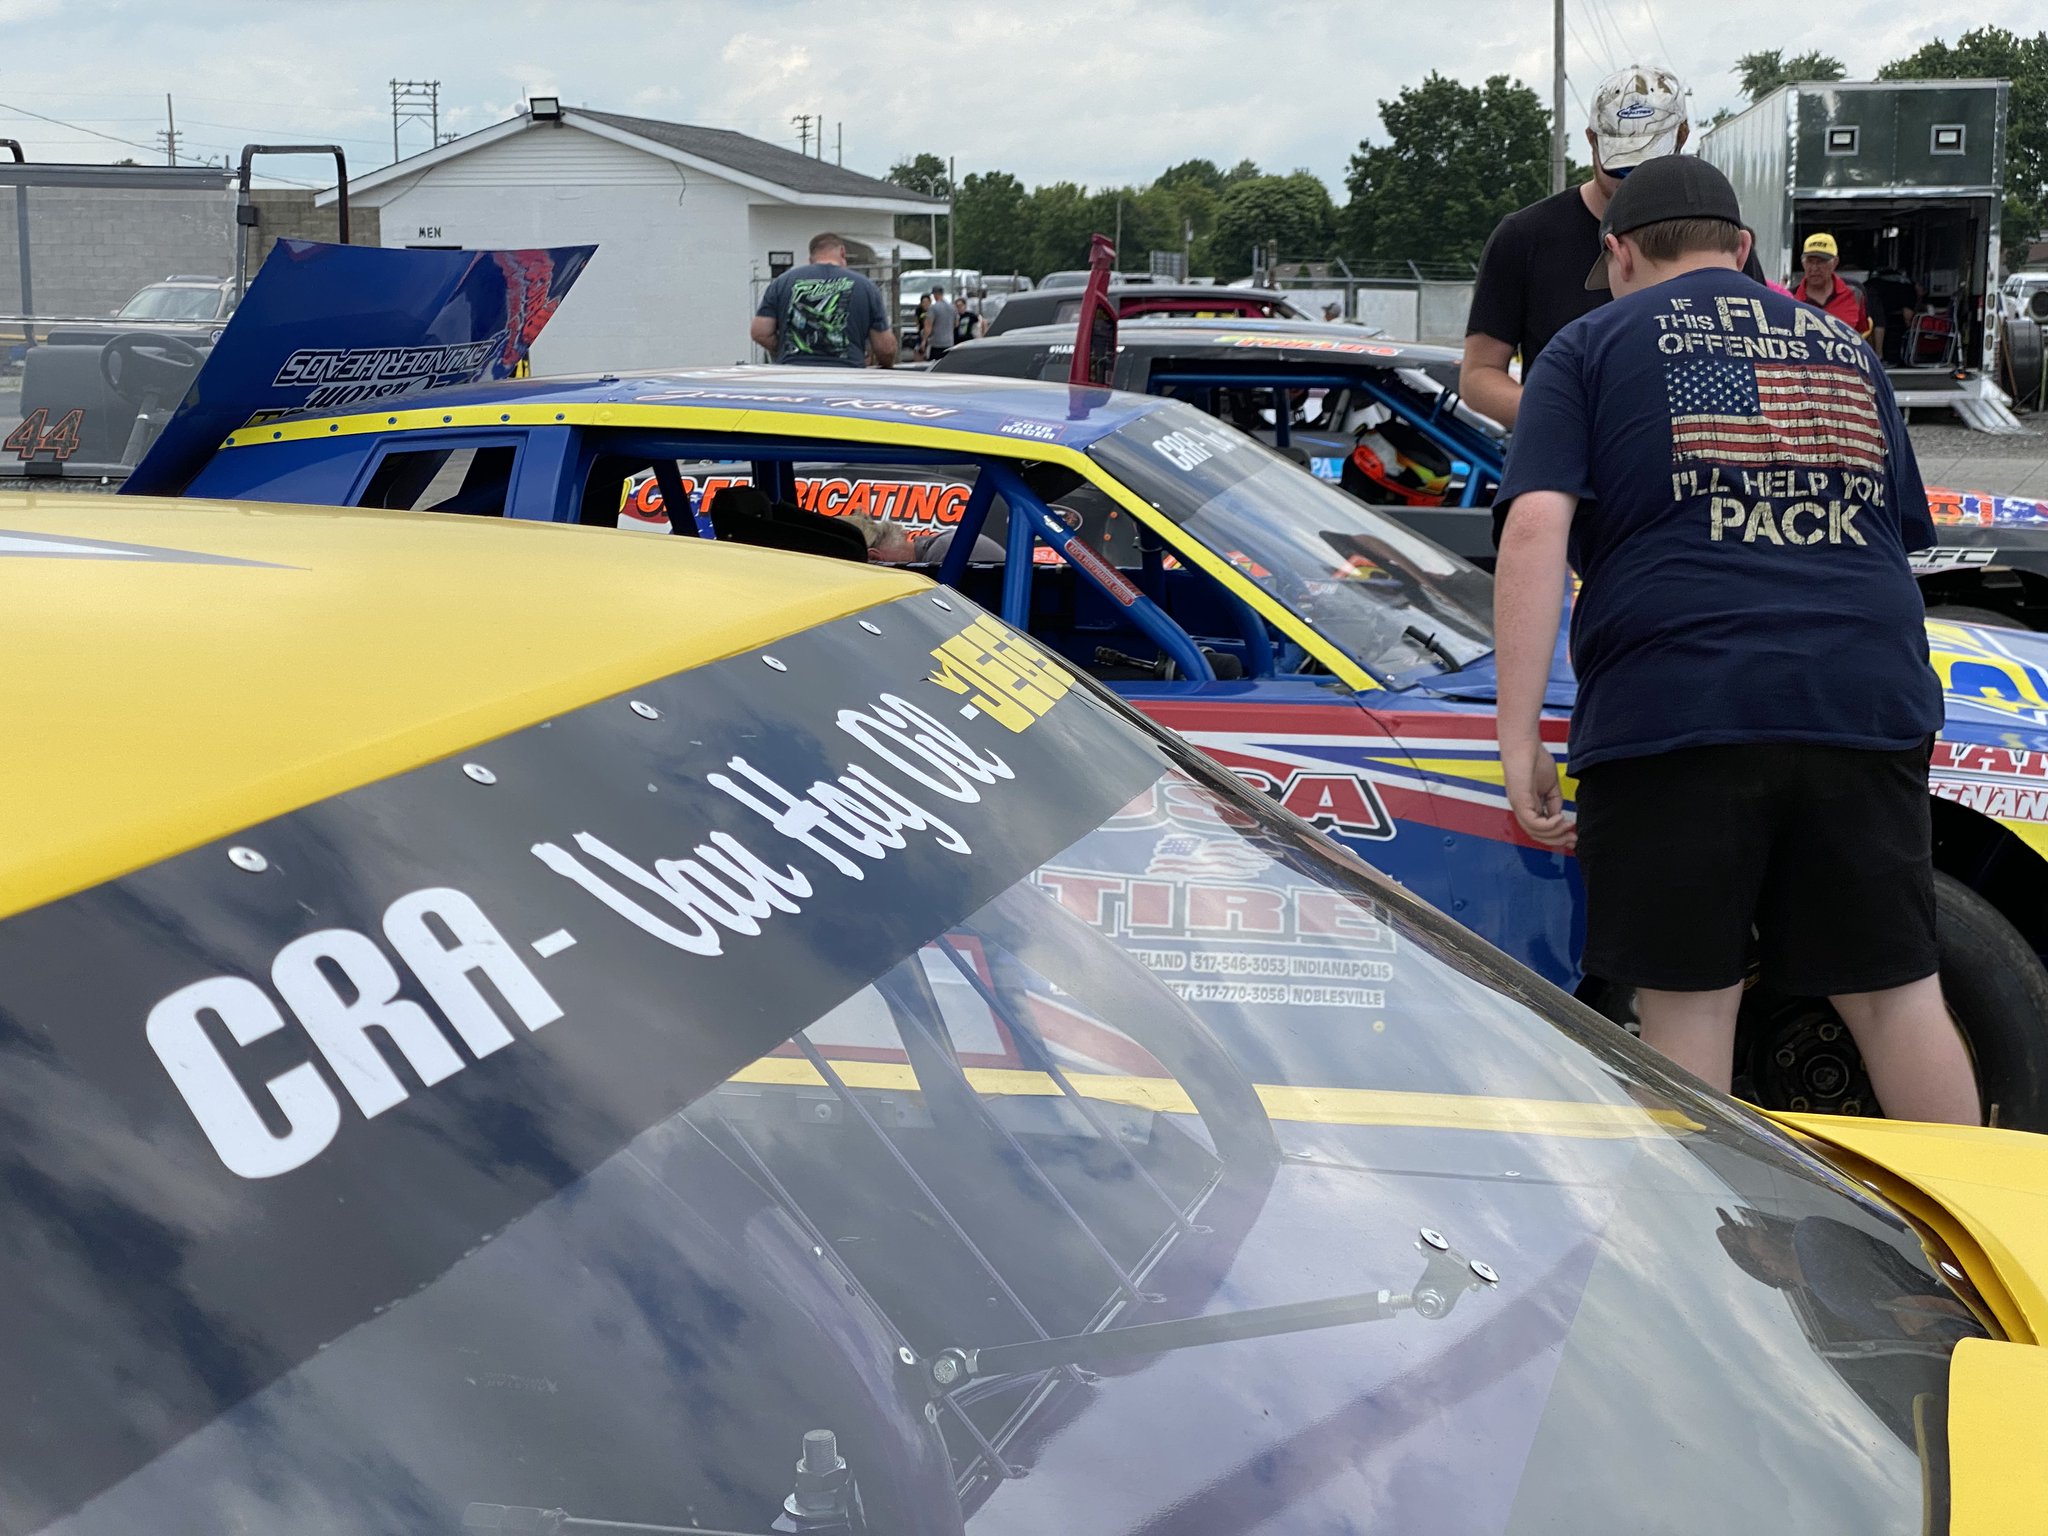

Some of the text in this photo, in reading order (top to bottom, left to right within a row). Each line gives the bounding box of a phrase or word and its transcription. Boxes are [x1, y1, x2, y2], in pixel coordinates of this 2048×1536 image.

[418, 226, 442, 239] MEN
[1653, 313, 1716, 331] THIS
[1670, 298, 1693, 311] IF
[1657, 332, 1870, 374] OFFENDS YOU
[3, 408, 85, 461] 44
[1000, 425, 1056, 440] RACER
[1152, 431, 1214, 472] CRA
[698, 476, 973, 528] FRICATING
[1671, 467, 1731, 501] I'LL
[1740, 470, 1830, 498] HELP
[1840, 471, 1886, 507] YOU
[1709, 496, 1869, 547] PACK
[920, 613, 1077, 734] JEGS
[835, 691, 1016, 804] Oil
[707, 755, 973, 882] Hoy
[530, 829, 815, 958] Van
[1029, 867, 1395, 951] TIRE
[1192, 953, 1287, 973] 317-546-3053
[1291, 959, 1391, 980] INDIANAPOLIS
[1195, 984, 1287, 1002] 317-770-3056
[1291, 988, 1383, 1006] NOBLESVILLE
[144, 886, 566, 1182] CRA
